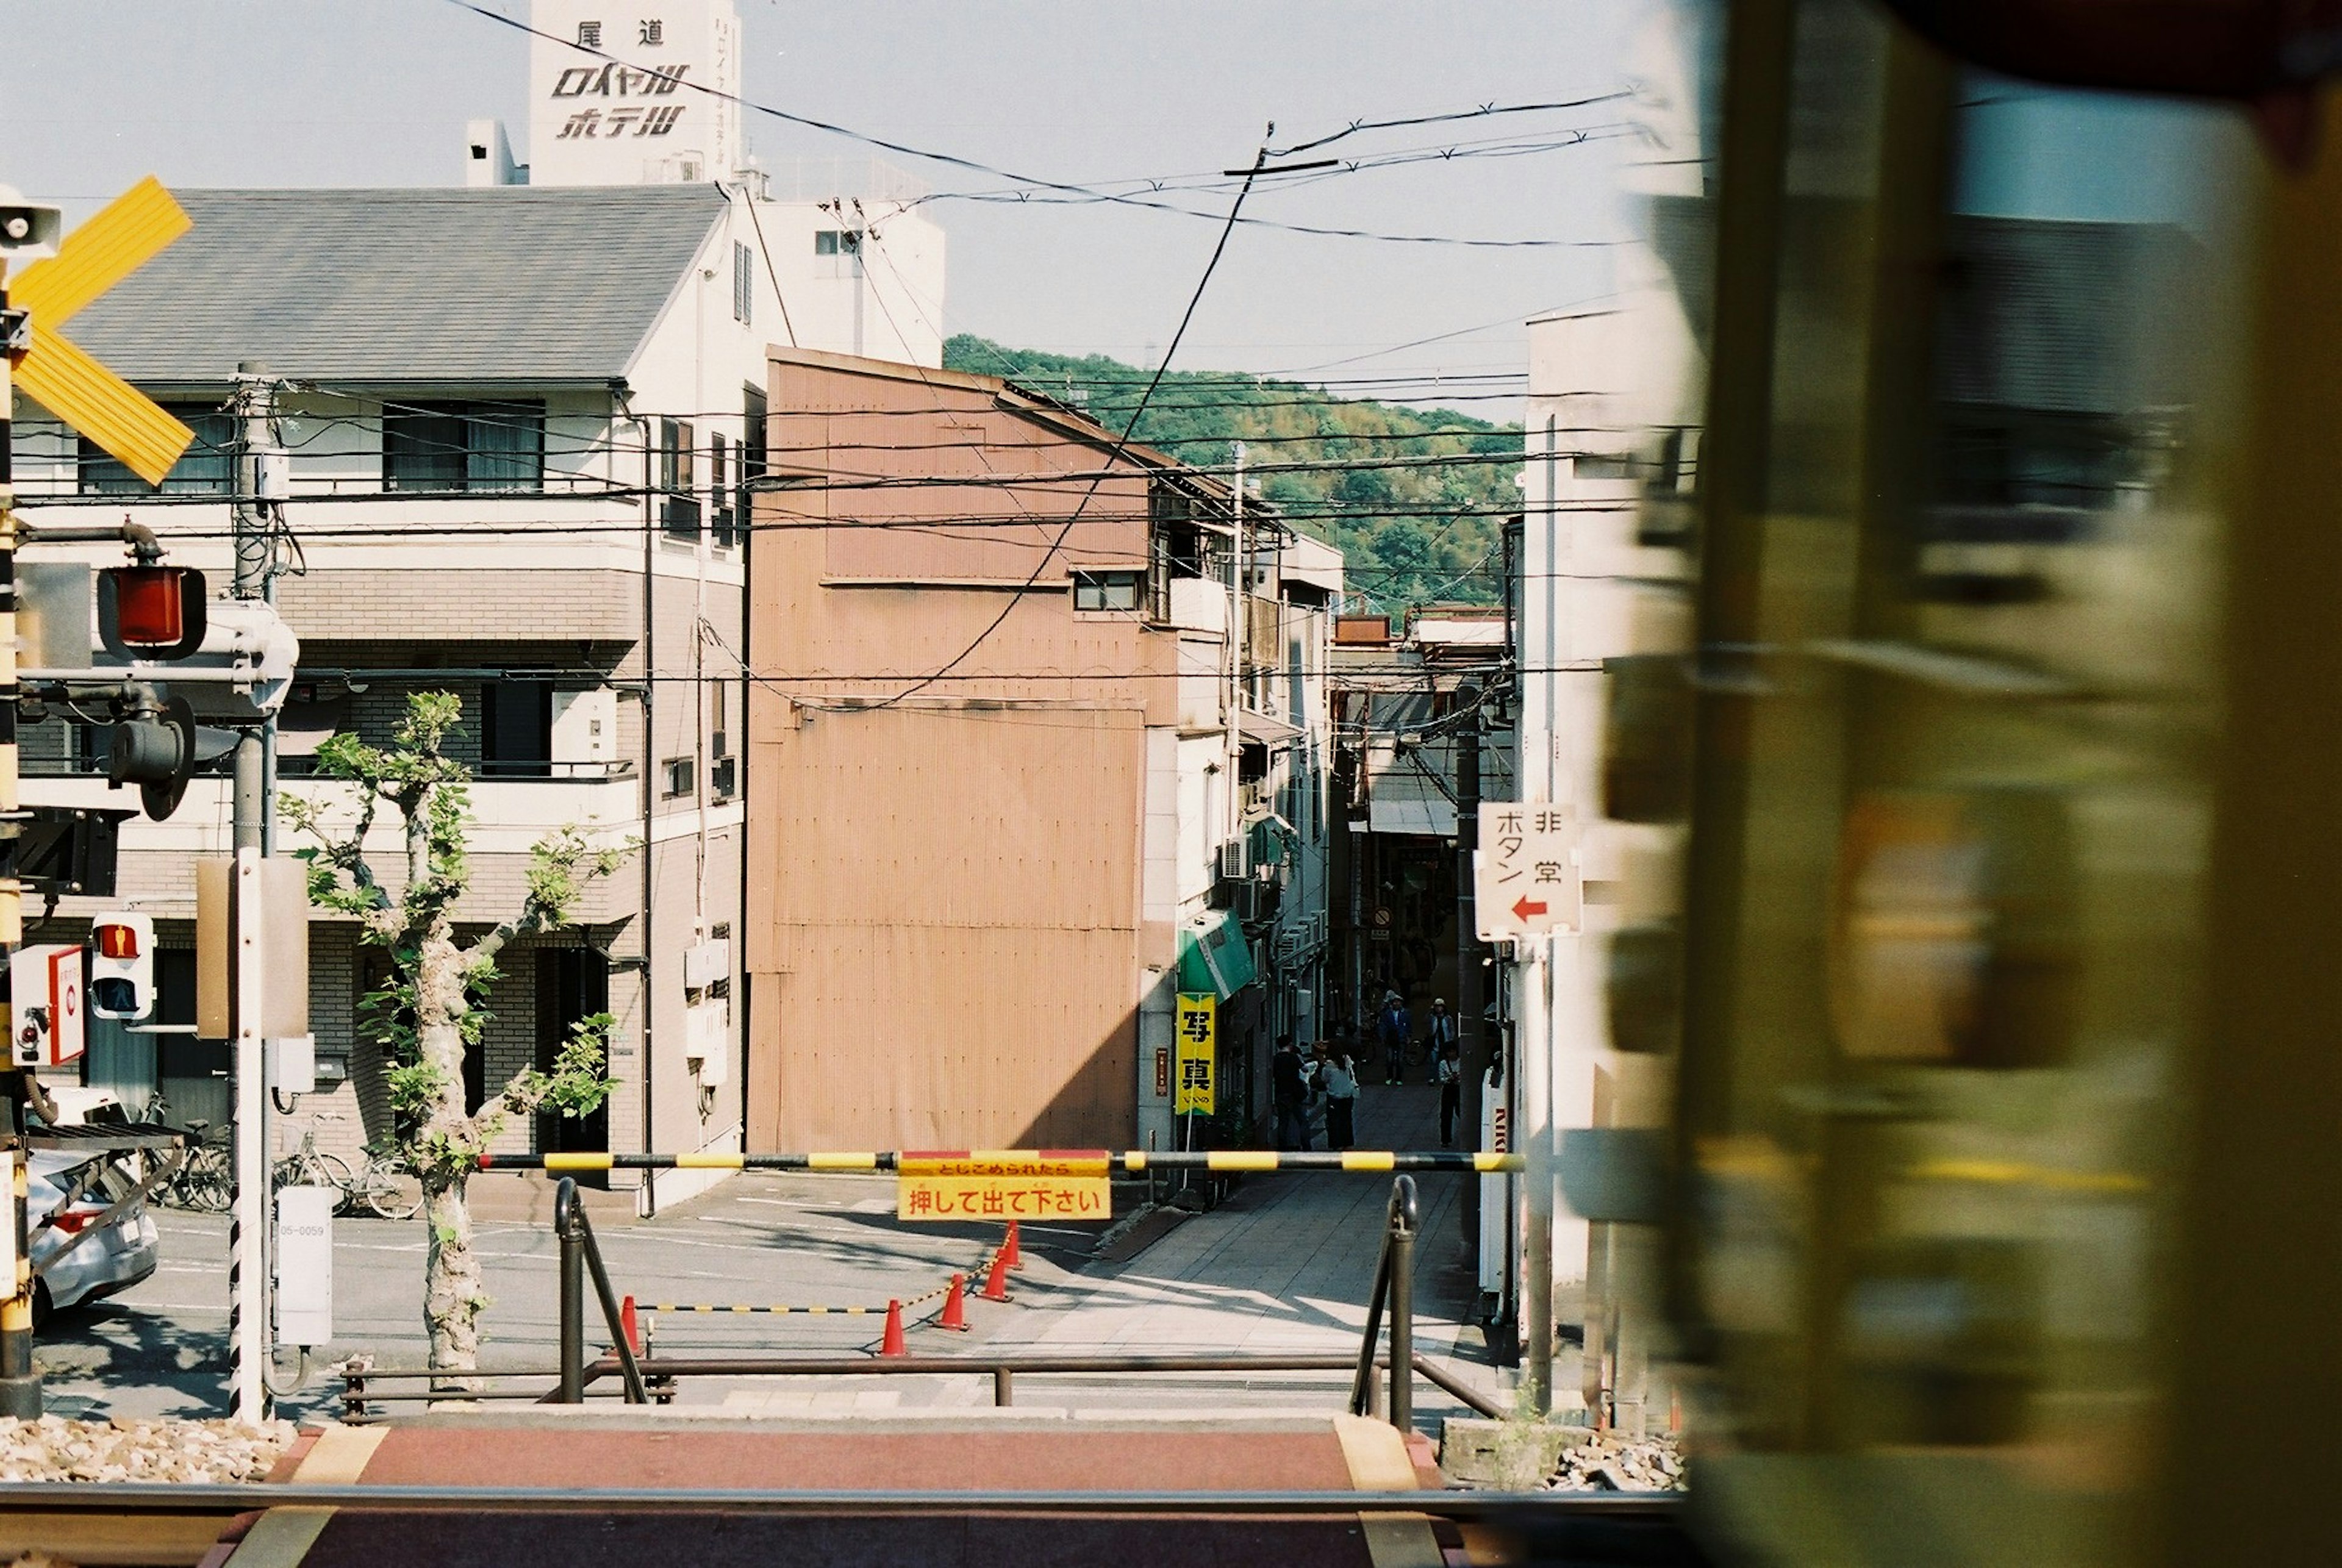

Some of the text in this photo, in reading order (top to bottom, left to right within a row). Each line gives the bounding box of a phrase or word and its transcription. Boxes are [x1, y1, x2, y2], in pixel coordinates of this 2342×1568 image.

[578, 20, 664, 47] 尾道
[551, 62, 690, 96] ロイヤル
[556, 106, 686, 139] ホテル
[1497, 811, 1523, 883] ボタン
[1535, 811, 1561, 884] 非常
[1183, 1011, 1211, 1090] 写真
[939, 1164, 1070, 1175] とじこめられたら
[909, 1189, 1101, 1215] 押して出て下さい
[281, 1225, 324, 1236] 05-0059
